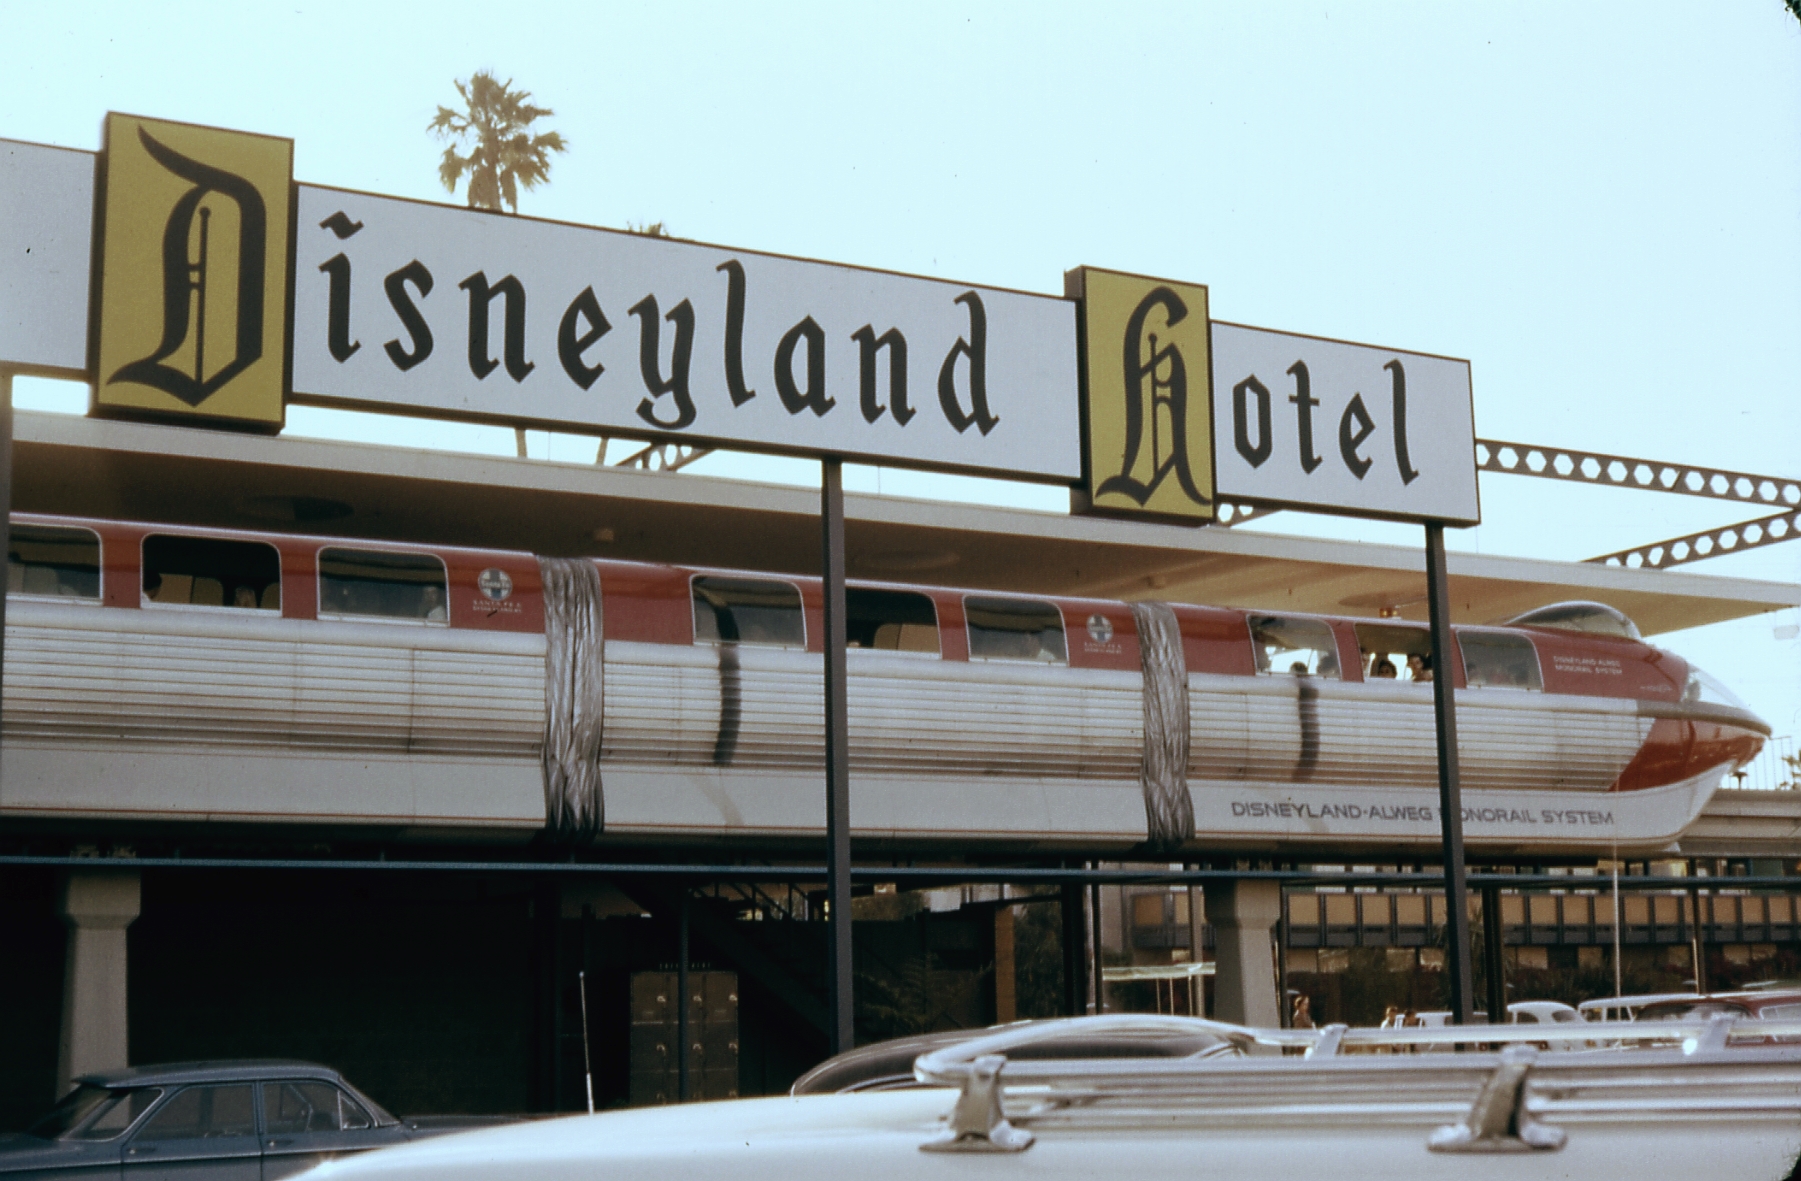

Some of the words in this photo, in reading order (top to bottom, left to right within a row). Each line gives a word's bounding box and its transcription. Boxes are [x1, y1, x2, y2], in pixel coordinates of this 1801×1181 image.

[106, 124, 1000, 429] Disneyland
[1094, 285, 1419, 506] Hotel
[1438, 807, 1537, 823] ONORAIL
[1541, 809, 1614, 825] SYSTEM
